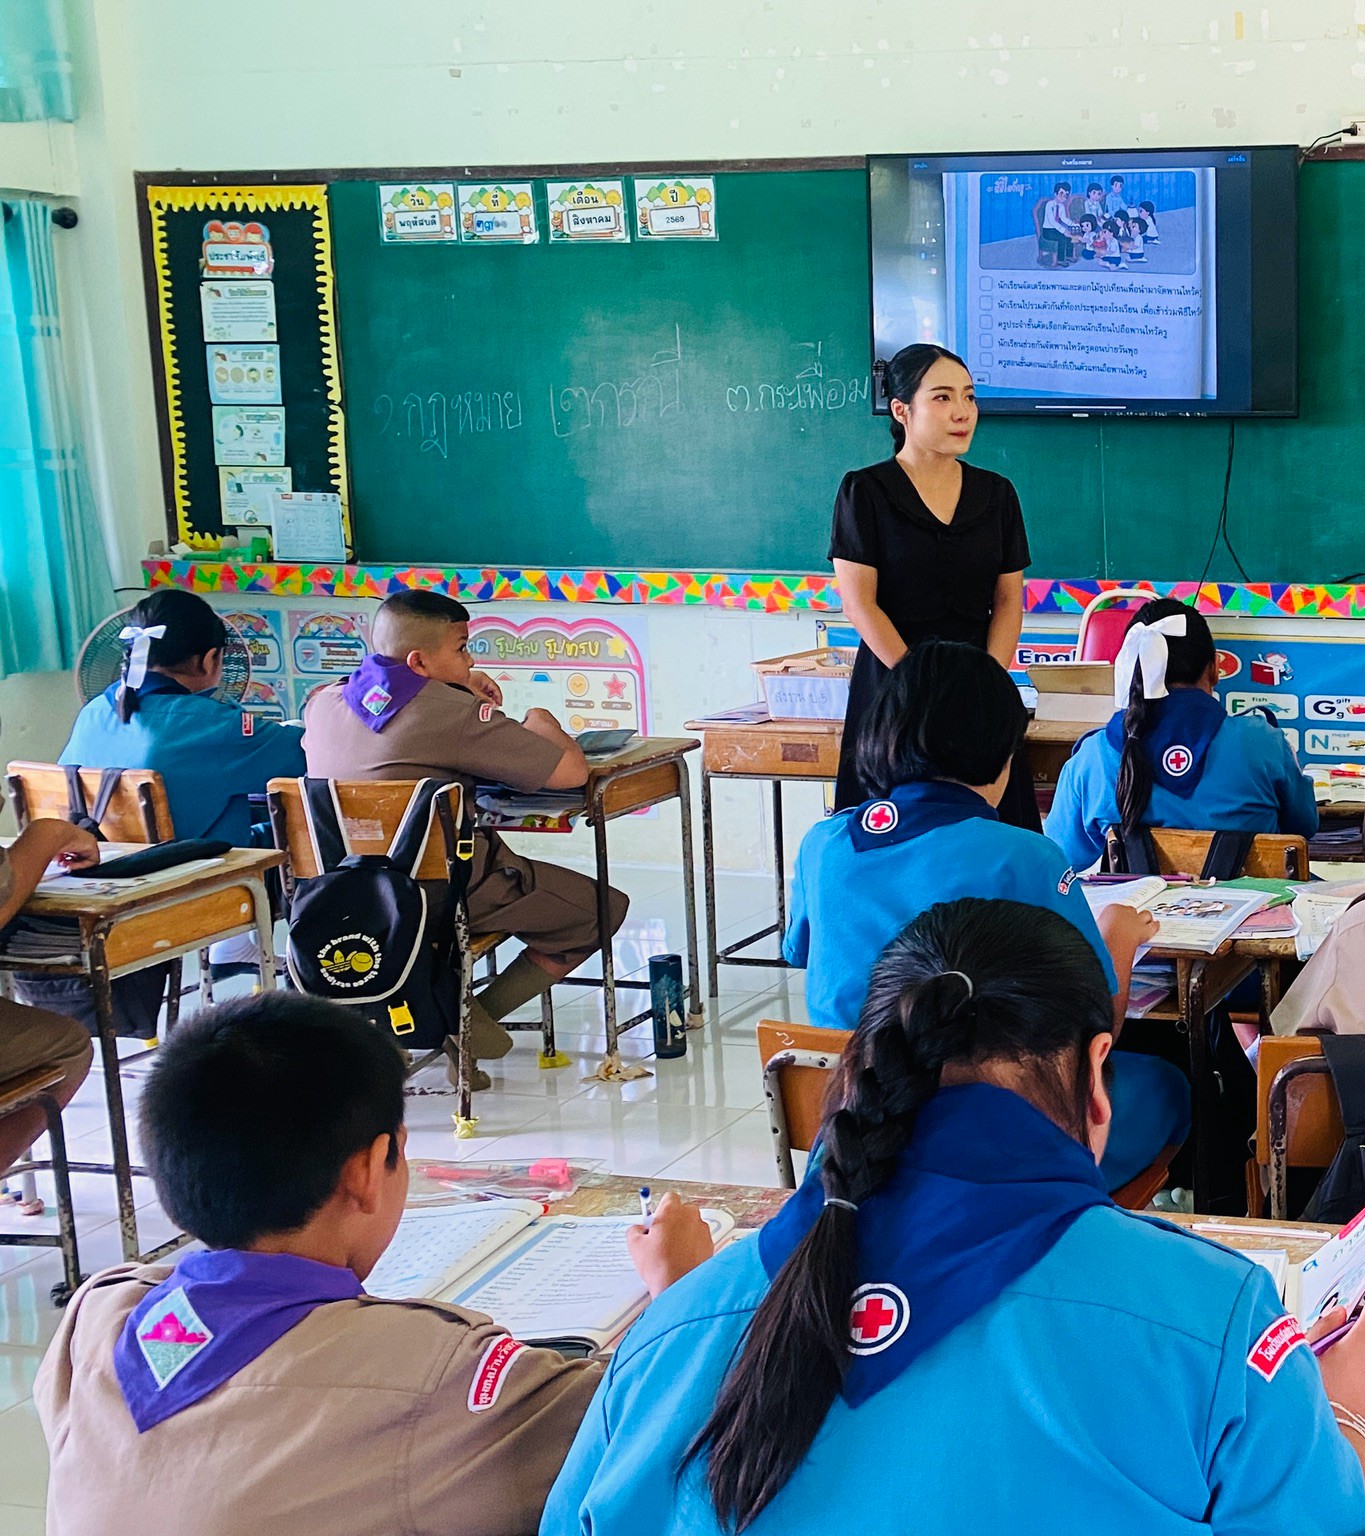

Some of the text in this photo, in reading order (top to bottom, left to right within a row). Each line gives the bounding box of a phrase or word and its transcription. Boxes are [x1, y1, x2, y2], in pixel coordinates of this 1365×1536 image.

[409, 195, 424, 206] วัน
[491, 190, 499, 207] ที่
[572, 190, 599, 204] เดือน
[670, 189, 679, 203] ปี
[399, 213, 437, 228] พฤหัสบดี
[572, 212, 612, 226] สิงหาคม
[666, 216, 685, 224] 2569
[359, 615, 367, 624] 1.
[494, 635, 539, 660] รูปร่าง
[544, 637, 599, 661] รูปทรง
[1231, 699, 1246, 714] F
[1313, 697, 1351, 720] G g gift
[1311, 734, 1329, 750] N
[317, 932, 383, 988] the brand with the three stripes
